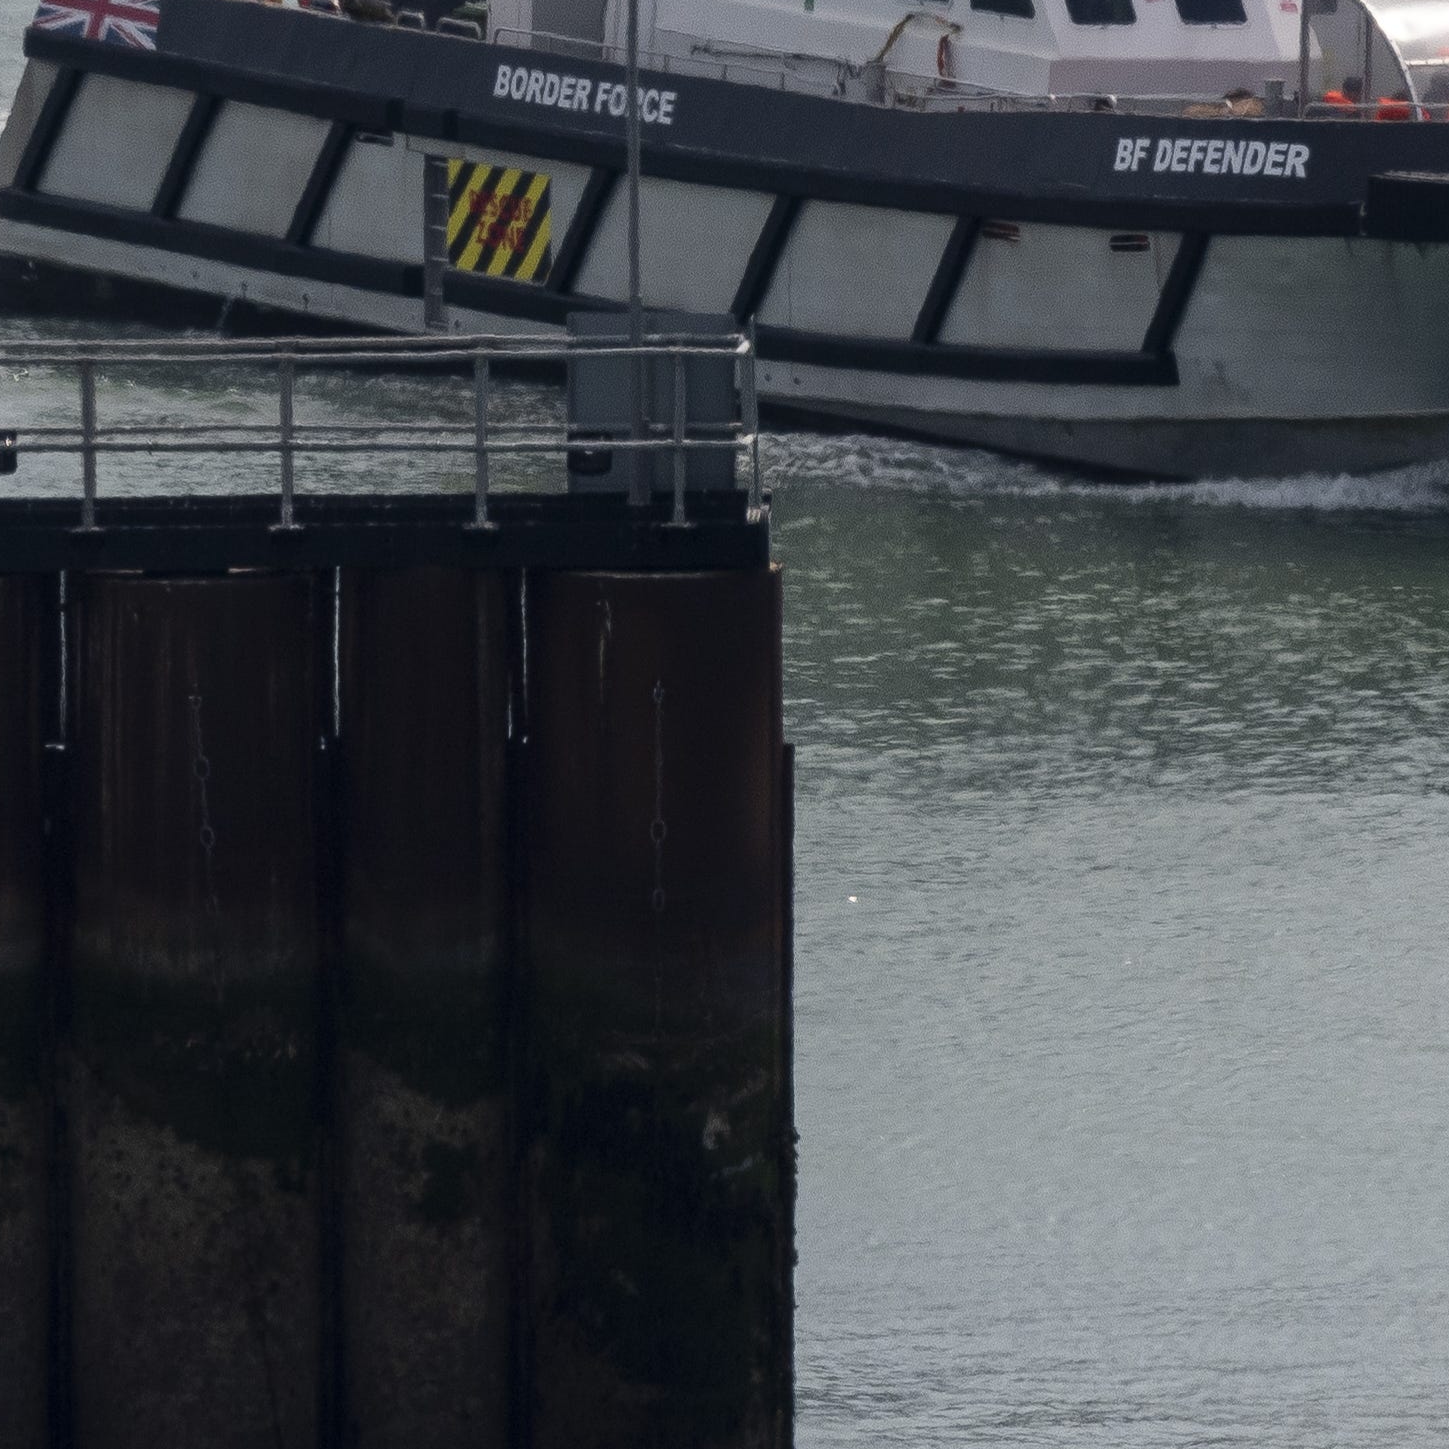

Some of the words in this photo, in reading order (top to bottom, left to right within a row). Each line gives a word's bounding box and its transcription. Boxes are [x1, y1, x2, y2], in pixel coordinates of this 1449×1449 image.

[493, 65, 592, 112] BORDER
[1113, 138, 1151, 172] BF
[1153, 138, 1310, 178] DEFENDER
[469, 189, 533, 222] RESCUE
[476, 220, 526, 254] ZONE
